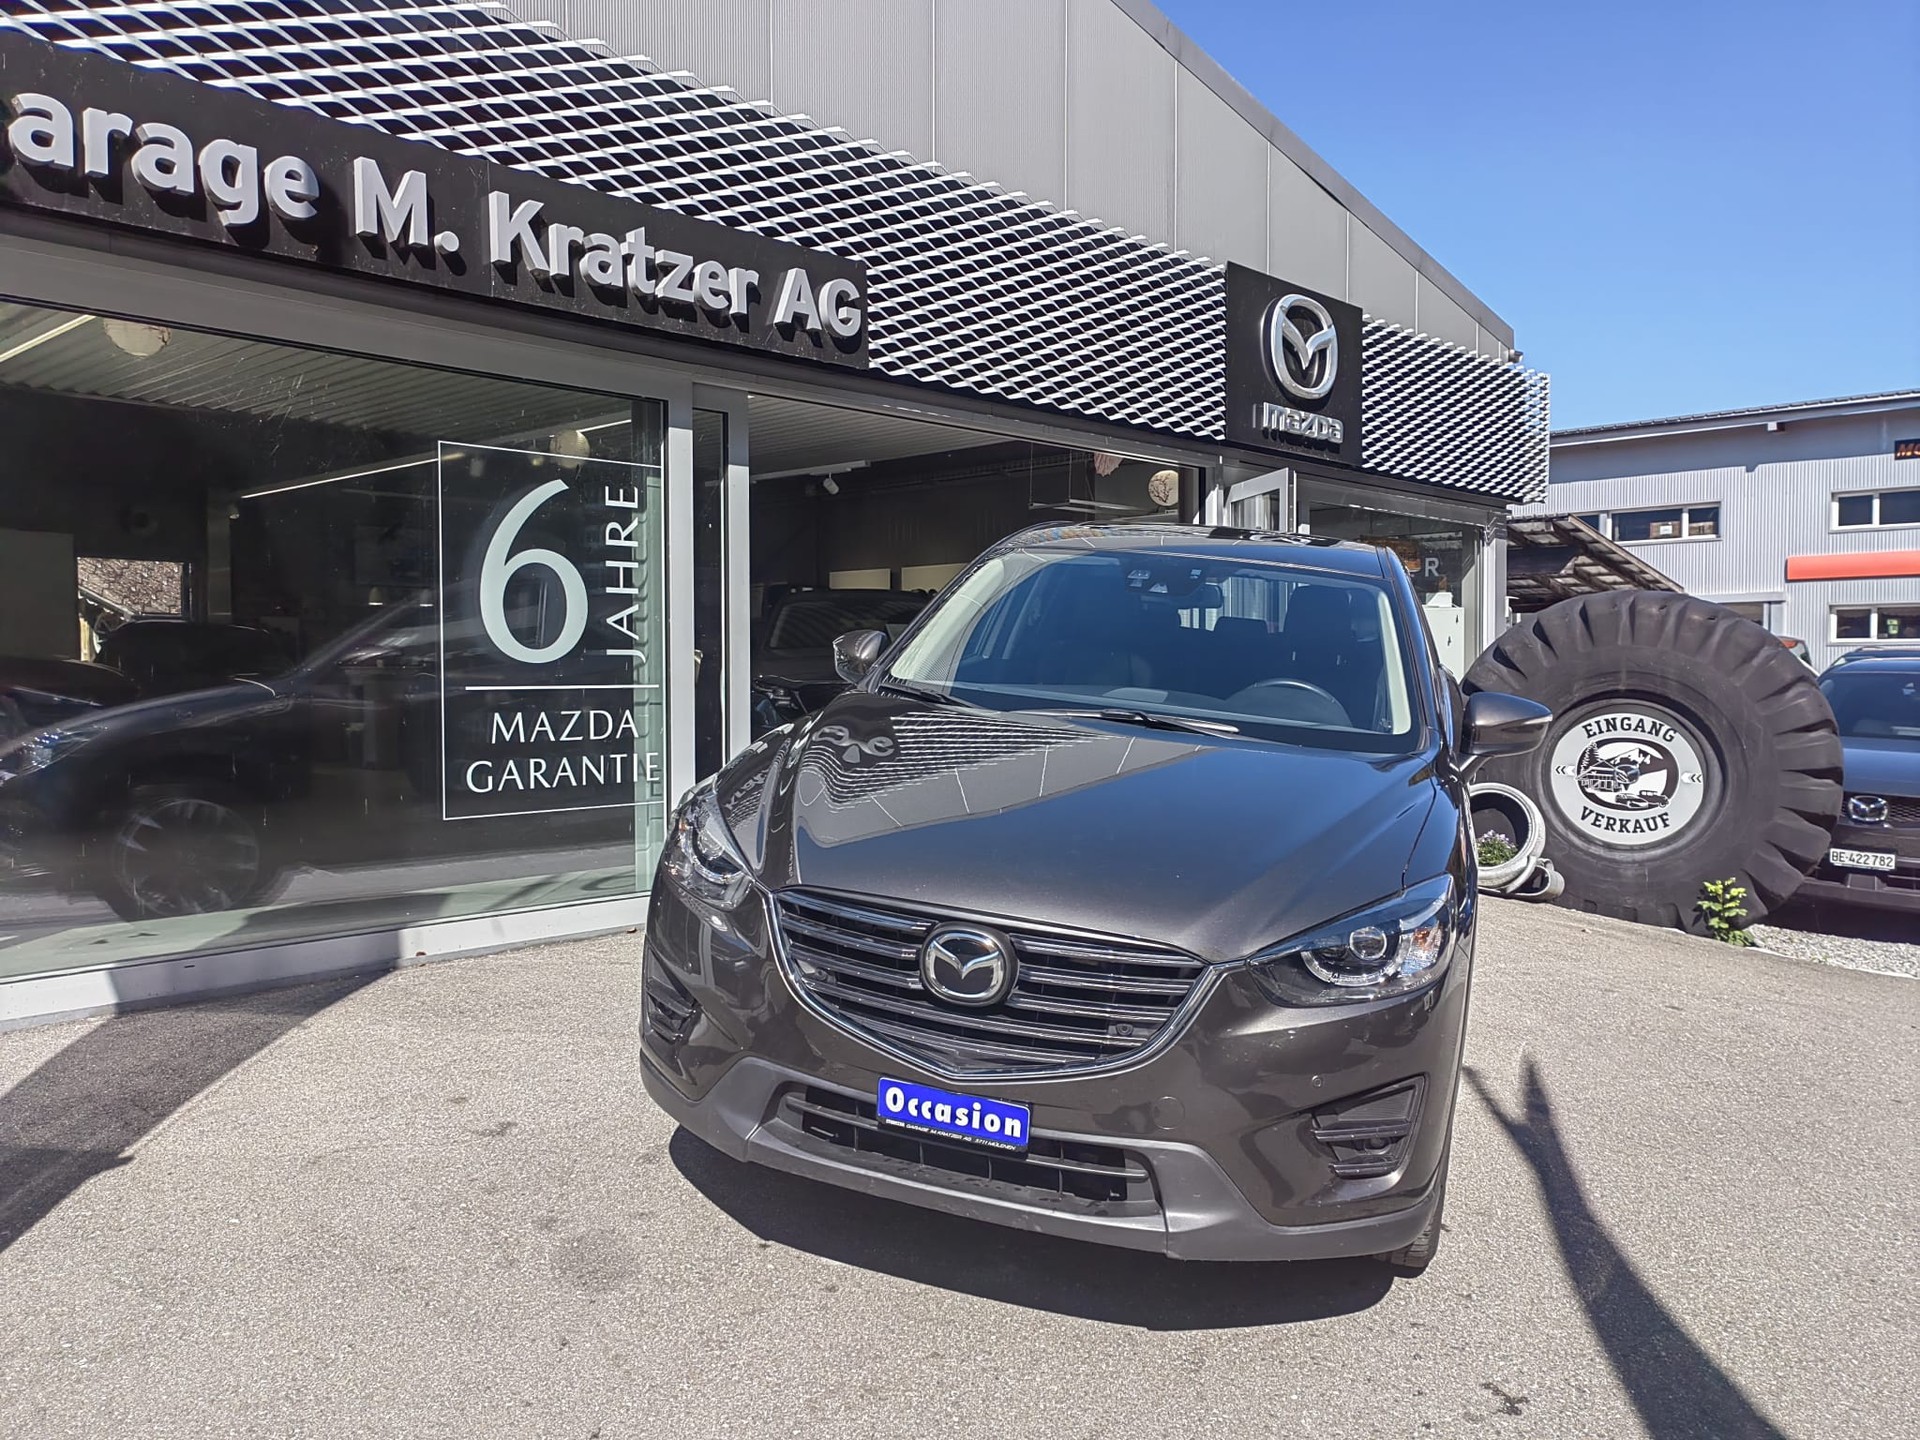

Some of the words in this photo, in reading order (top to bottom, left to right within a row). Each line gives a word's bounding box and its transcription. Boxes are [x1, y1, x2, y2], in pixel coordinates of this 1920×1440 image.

[353, 156, 459, 252] M.
[488, 190, 760, 316] Kratzer
[773, 267, 862, 338] AG
[480, 479, 588, 664] 6
[605, 485, 646, 663] JAHRE
[491, 709, 639, 744] MAZDA
[1582, 717, 1677, 743] EINGANG
[466, 752, 661, 793] GARANTIE
[1580, 806, 1671, 834] VERKAUF
[885, 1086, 1022, 1139] Occasion
